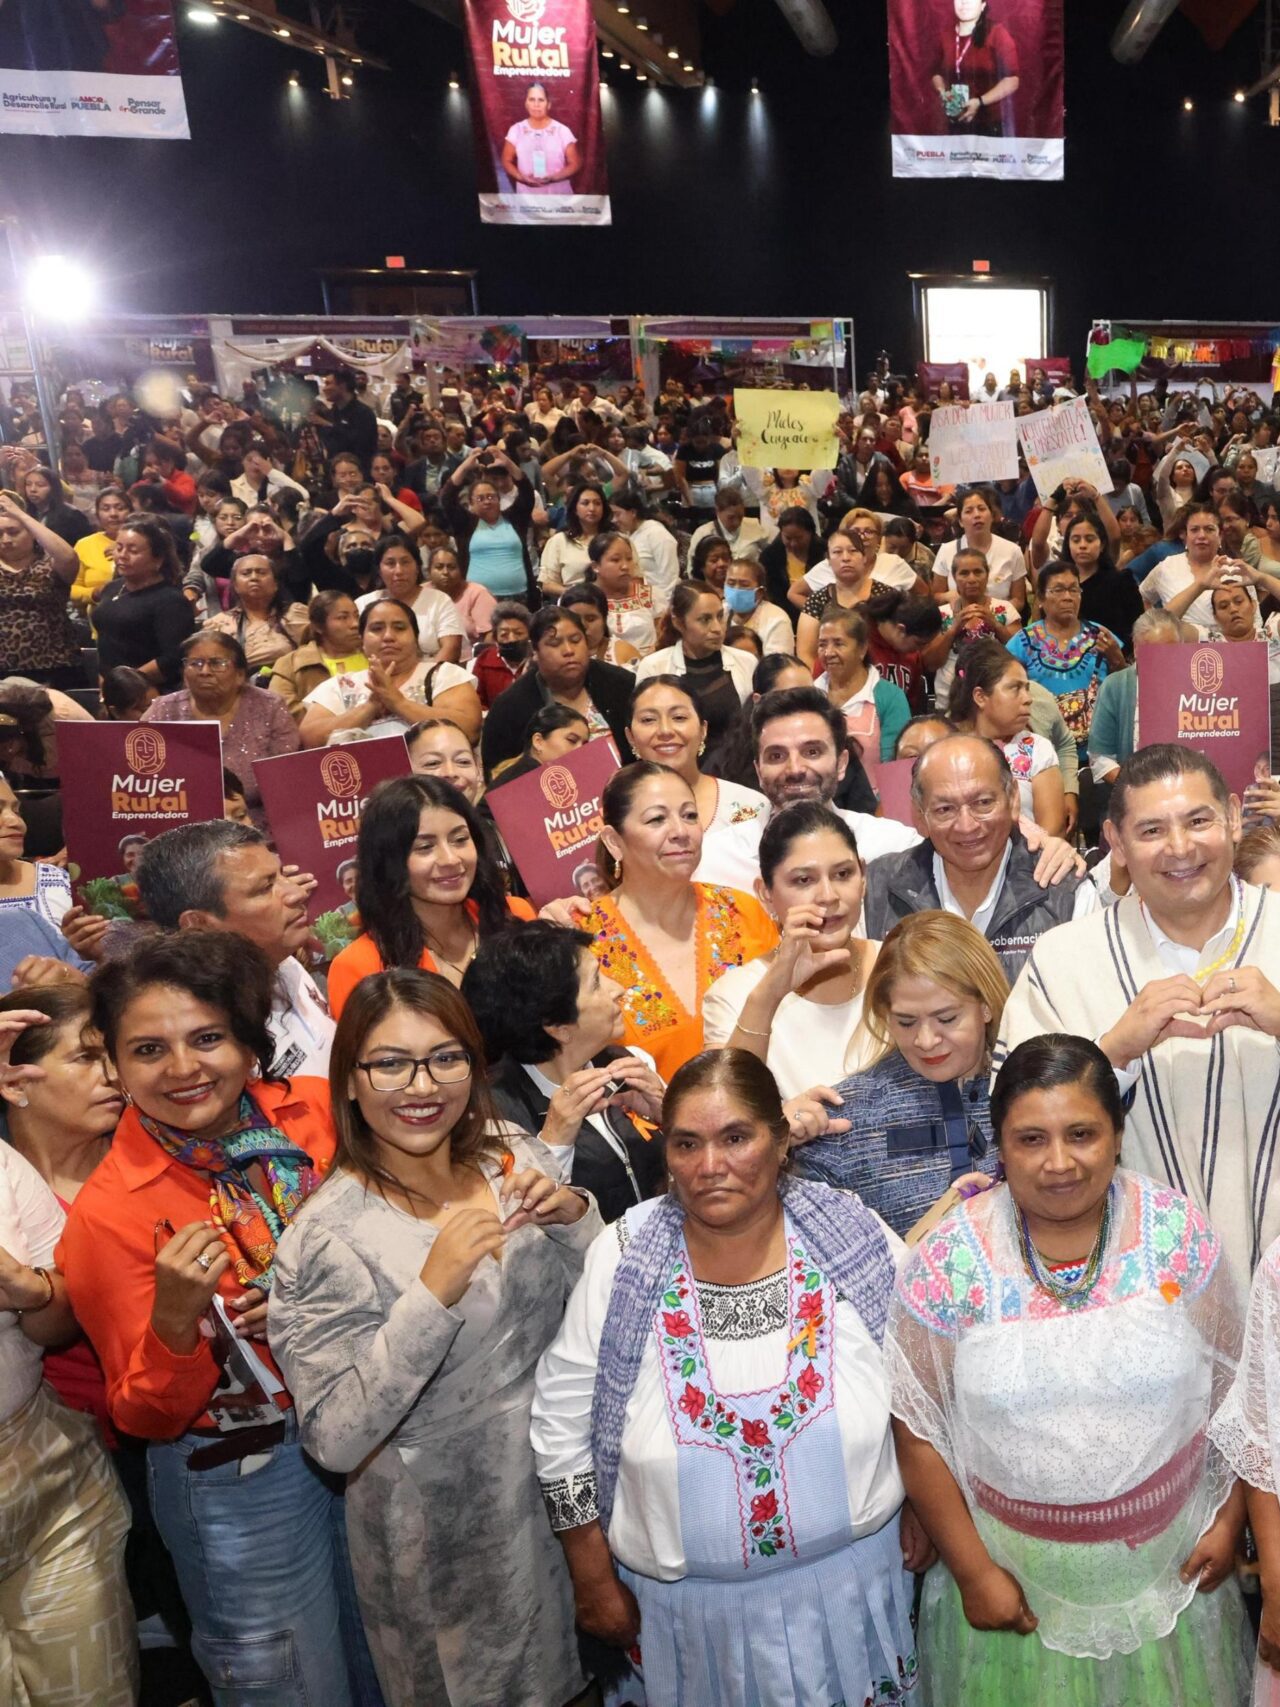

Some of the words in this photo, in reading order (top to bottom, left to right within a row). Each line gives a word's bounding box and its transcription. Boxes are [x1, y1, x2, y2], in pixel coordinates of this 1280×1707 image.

[492, 20, 566, 50] Mujer
[492, 42, 569, 68] Rural
[493, 66, 571, 77] Emprendedora
[3, 93, 51, 102] Agricultura
[128, 98, 161, 108] Pensar
[71, 102, 111, 111] PUEBLA
[130, 106, 166, 115] Grande
[916, 150, 945, 158] PUEBLA
[1179, 693, 1238, 715] Mujer
[1178, 709, 1239, 730] Rural
[1178, 729, 1240, 740] Emprendedora
[112, 774, 185, 798] Mujer
[112, 790, 188, 812] Rural
[112, 811, 189, 820] Emprendedora
[544, 797, 599, 834] Mujer
